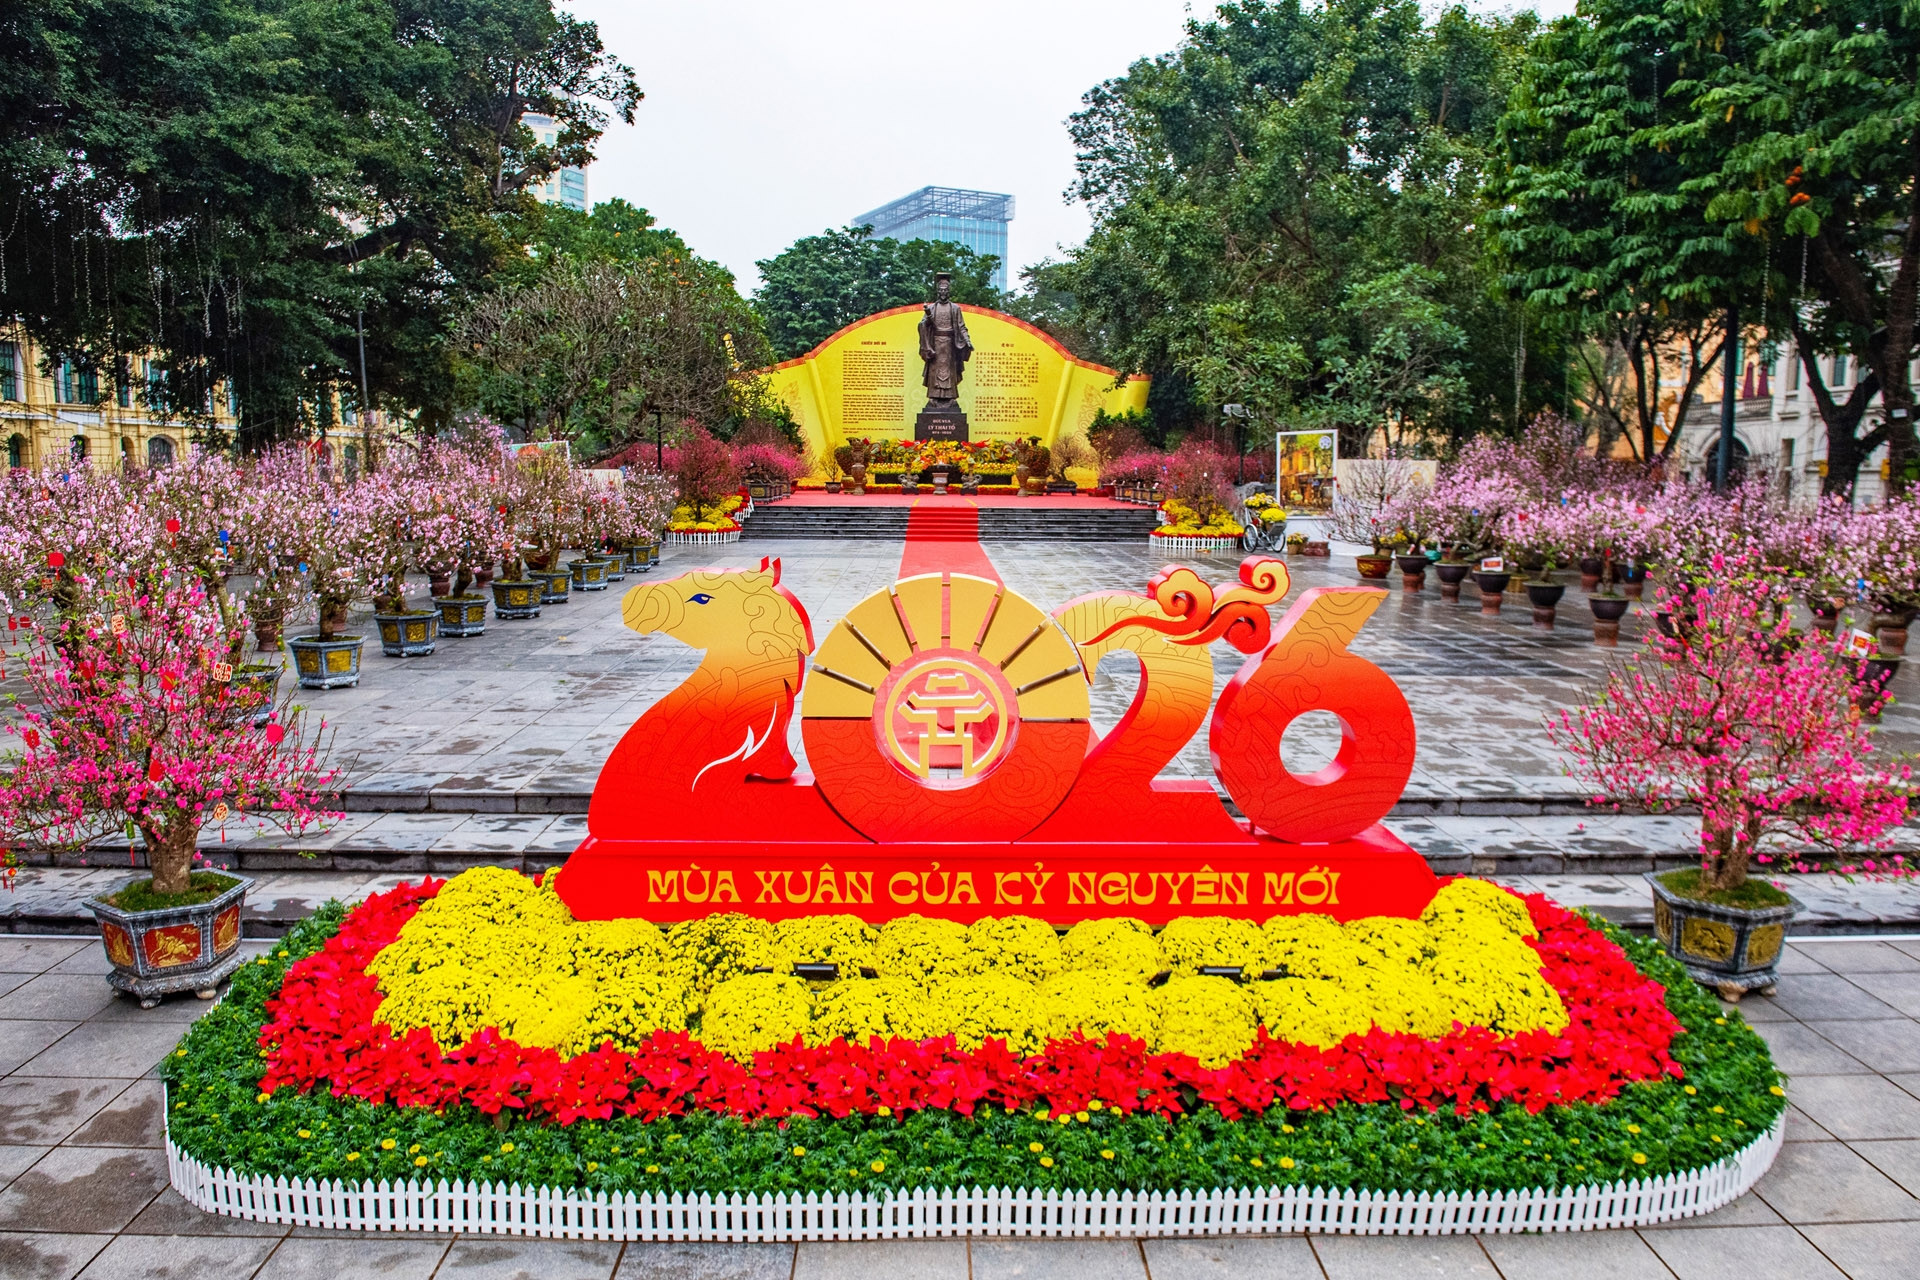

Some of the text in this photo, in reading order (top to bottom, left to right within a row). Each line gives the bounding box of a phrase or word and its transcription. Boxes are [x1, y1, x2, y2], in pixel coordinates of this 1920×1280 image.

[646, 861, 1341, 905] MÙA XUÂN CỦA KỶ NGUYÊN MỚI
